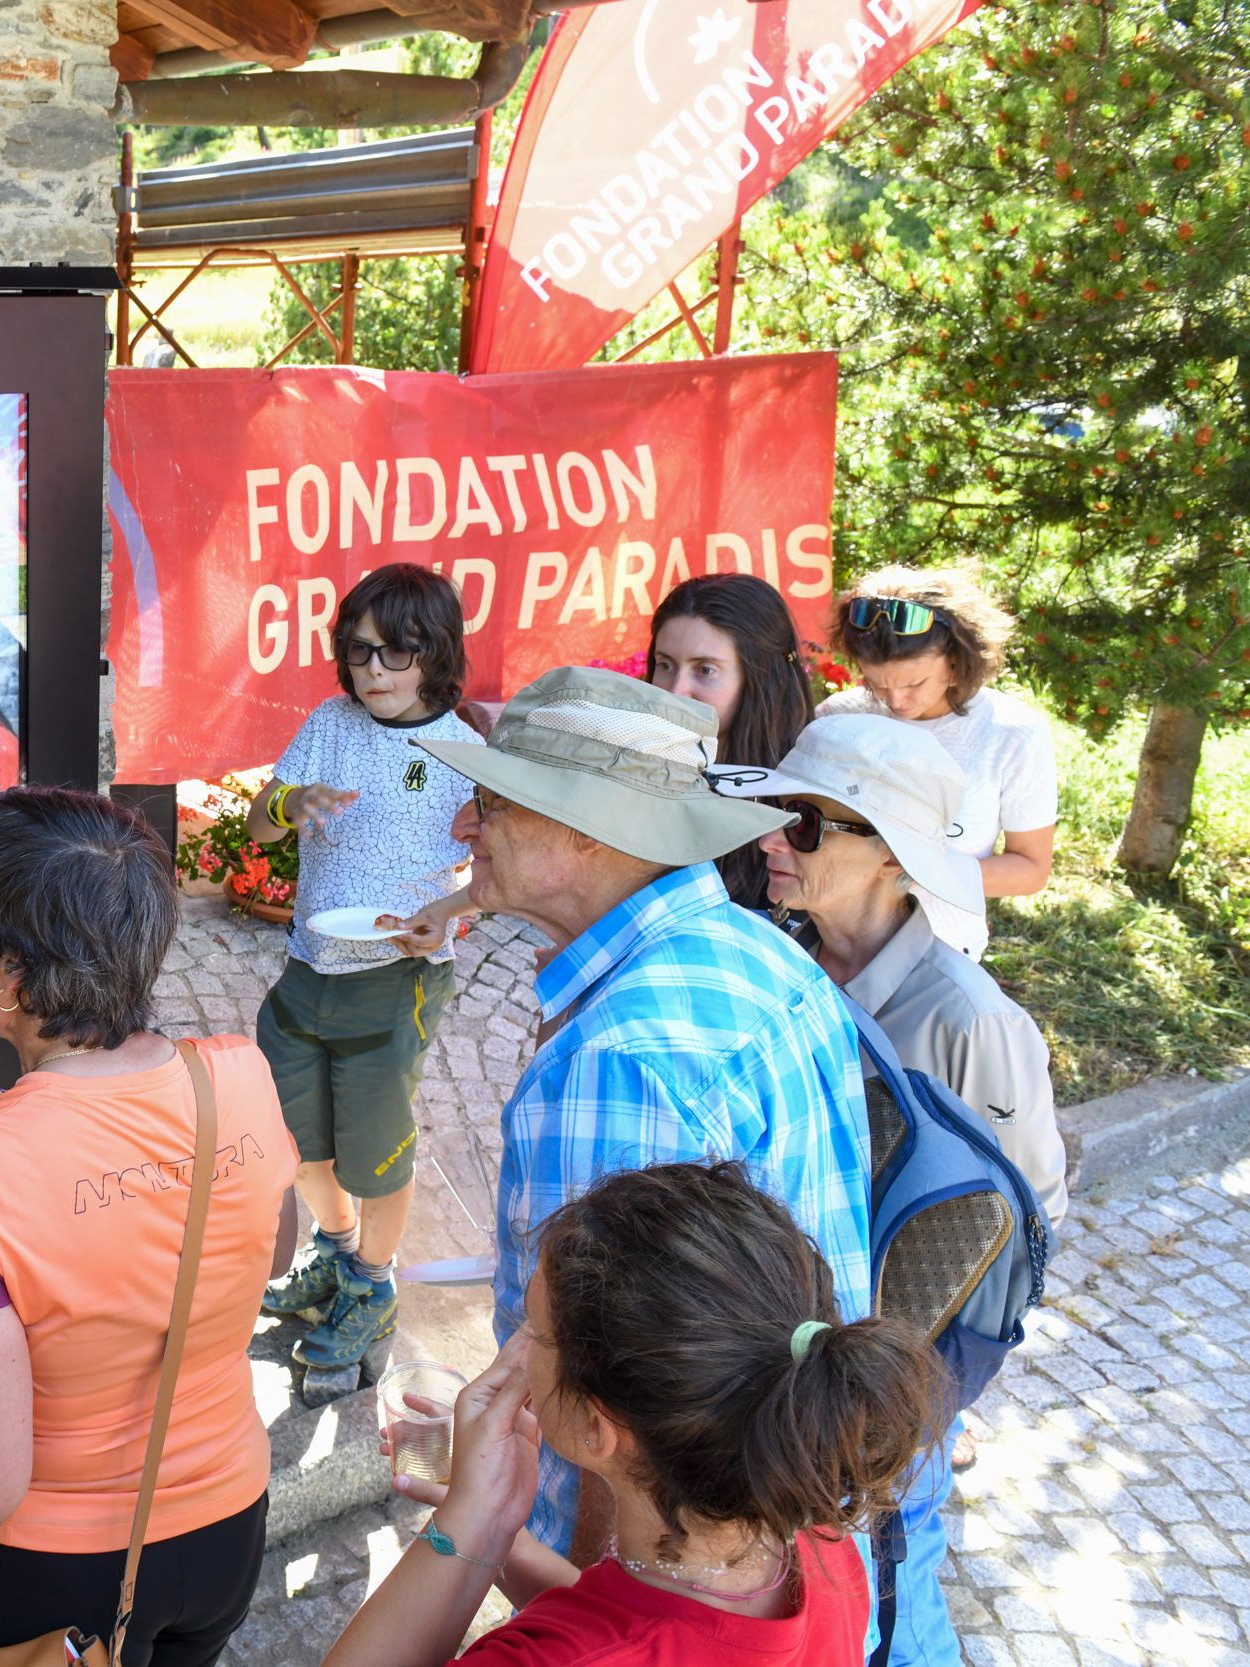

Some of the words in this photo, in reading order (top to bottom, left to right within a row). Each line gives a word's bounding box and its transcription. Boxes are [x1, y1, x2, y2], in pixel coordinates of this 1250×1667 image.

[519, 50, 774, 303] FONDATION
[601, 131, 760, 289] GRAND
[246, 444, 658, 562] FONDATION
[247, 557, 497, 675] GRD
[374, 1125, 419, 1176] END
